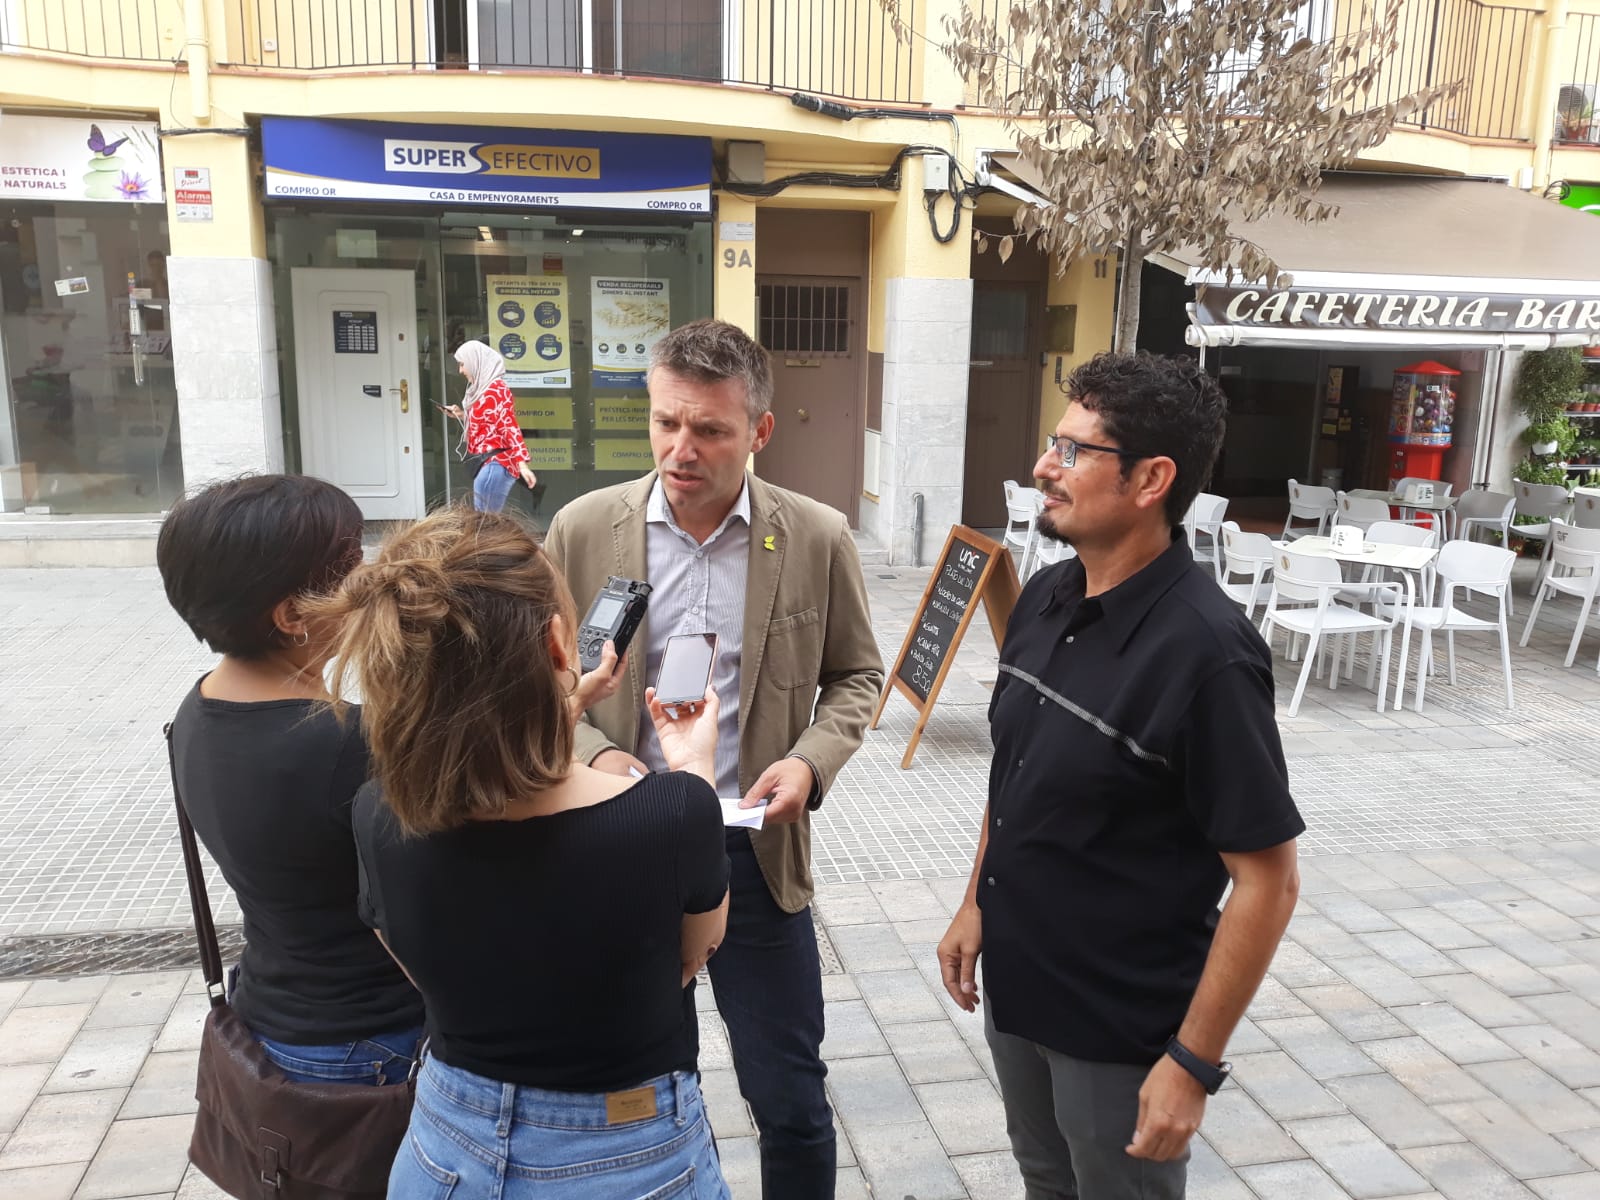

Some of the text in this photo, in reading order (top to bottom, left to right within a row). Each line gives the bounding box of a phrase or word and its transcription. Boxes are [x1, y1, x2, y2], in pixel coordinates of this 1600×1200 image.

[392, 147, 592, 173] SUPER EFECTIVO
[1, 166, 66, 177] ESTETICA I
[3, 179, 67, 190] NATURALS
[176, 191, 211, 201] Alarma
[275, 185, 337, 196] COMPRO OR
[429, 191, 455, 200] CASA
[468, 193, 560, 205] EMPENYORAMENTS
[647, 200, 703, 210] COMPRO OR
[723, 248, 752, 268] 9A
[1094, 258, 1107, 278] 11
[598, 280, 662, 290] VENDA RECUPERABLE
[1226, 289, 1491, 327] CAFETERIA
